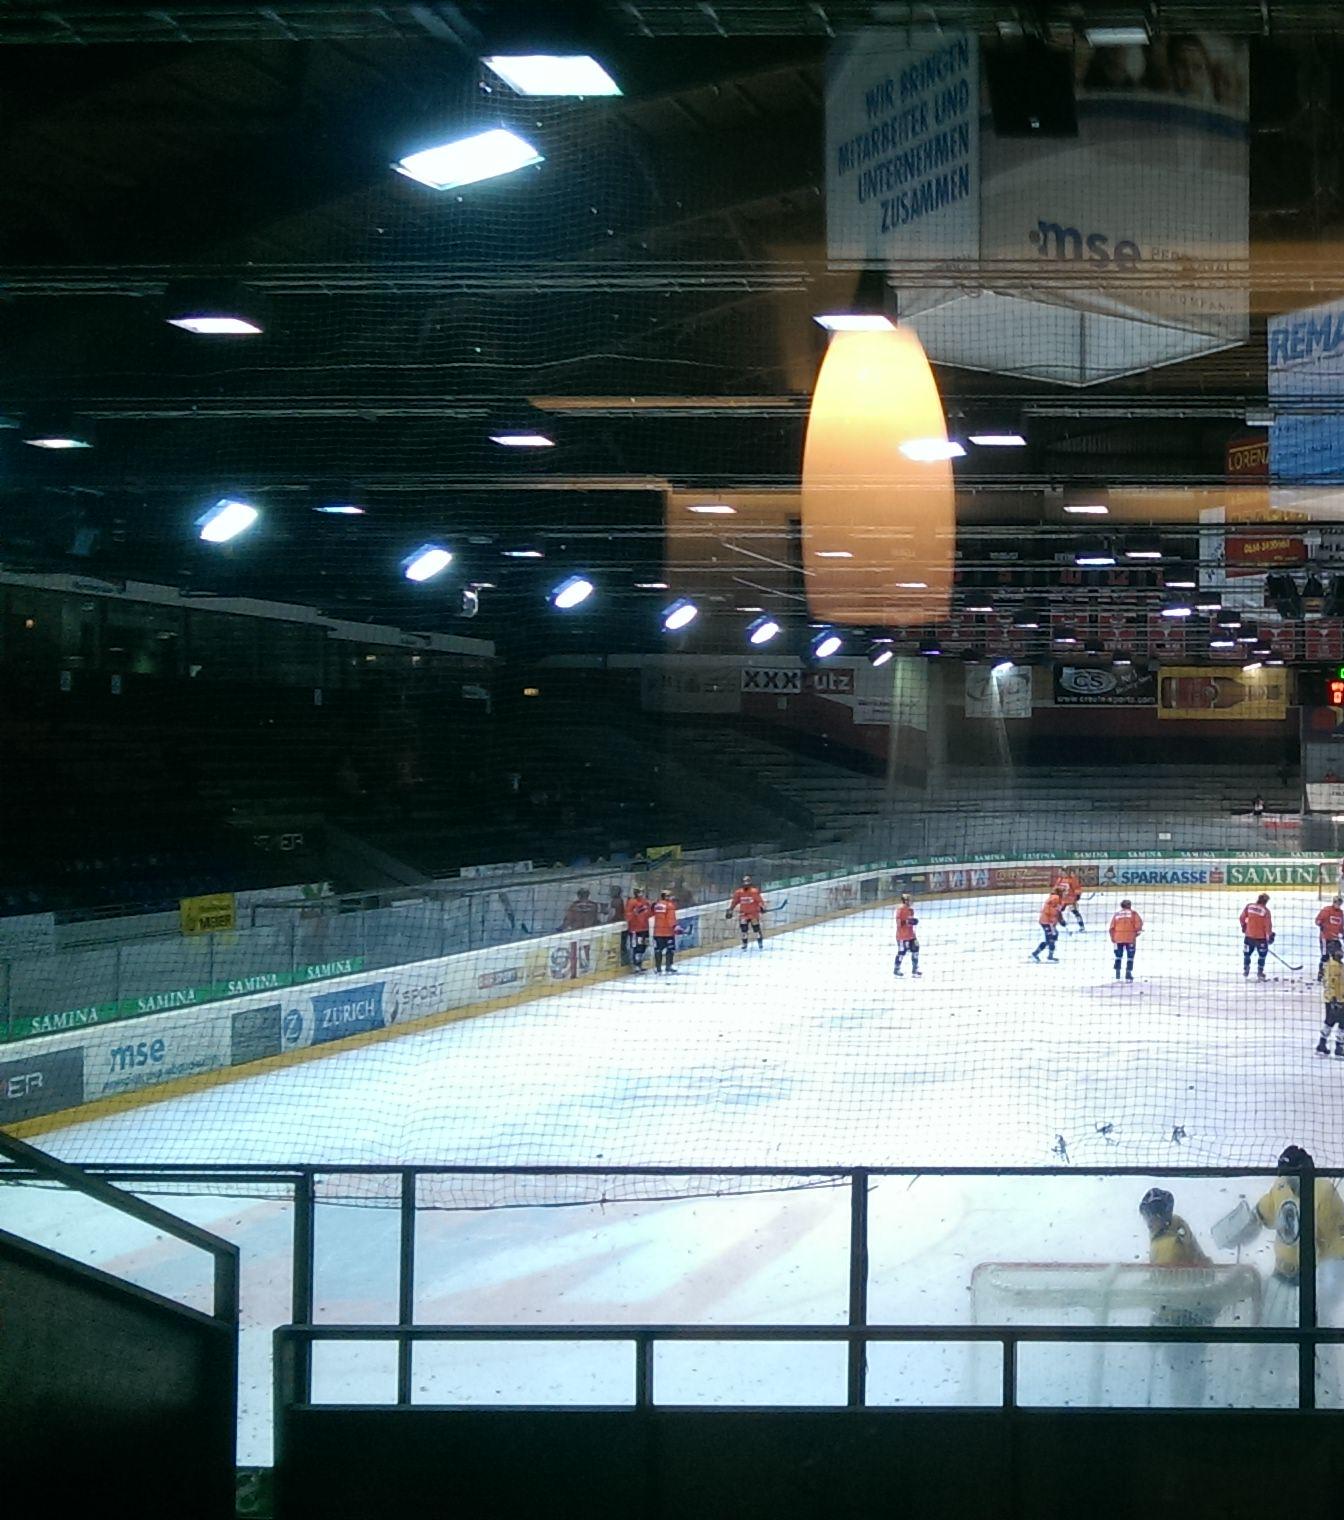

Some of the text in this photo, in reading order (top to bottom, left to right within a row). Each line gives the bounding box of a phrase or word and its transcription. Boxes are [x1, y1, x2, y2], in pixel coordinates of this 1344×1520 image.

[865, 37, 969, 119] WIR BRINGEN
[838, 78, 969, 176] MITARBEITER UND
[858, 121, 969, 204] UNTERNEHMEN
[880, 163, 969, 234] ZUSAMMEN
[1037, 219, 1141, 272] mse
[1121, 870, 1208, 885] SPARKASSE
[1231, 867, 1333, 885] SAMINA
[228, 973, 278, 995] SAMINA
[306, 959, 352, 980] SAMINA
[137, 988, 196, 1012] SAMINA
[322, 998, 376, 1028] ZURICH
[32, 1008, 99, 1034] SAMINA
[109, 1038, 166, 1073] mse
